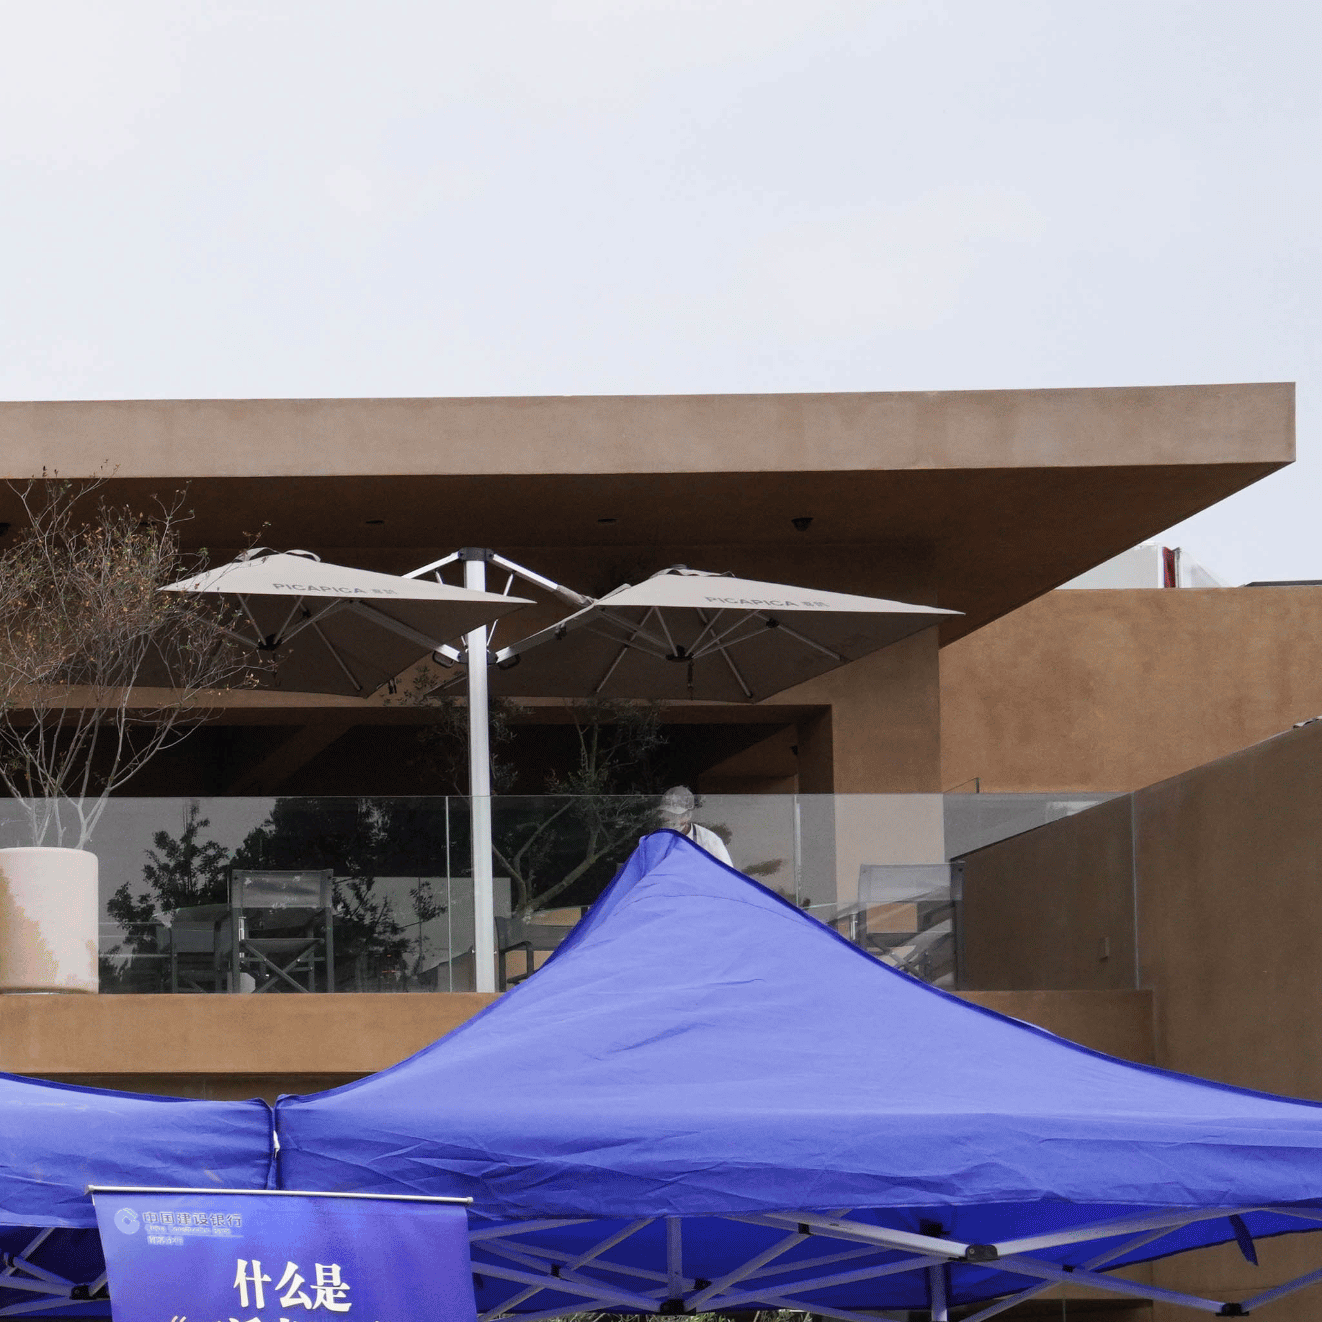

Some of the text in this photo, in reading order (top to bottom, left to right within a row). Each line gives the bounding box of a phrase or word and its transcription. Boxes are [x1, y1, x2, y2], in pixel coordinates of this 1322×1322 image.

[272, 583, 366, 594] PICAPICA
[704, 596, 799, 607] PICAPICA
[143, 1211, 242, 1227] 中国建设银行
[233, 1258, 352, 1312] 什么是
